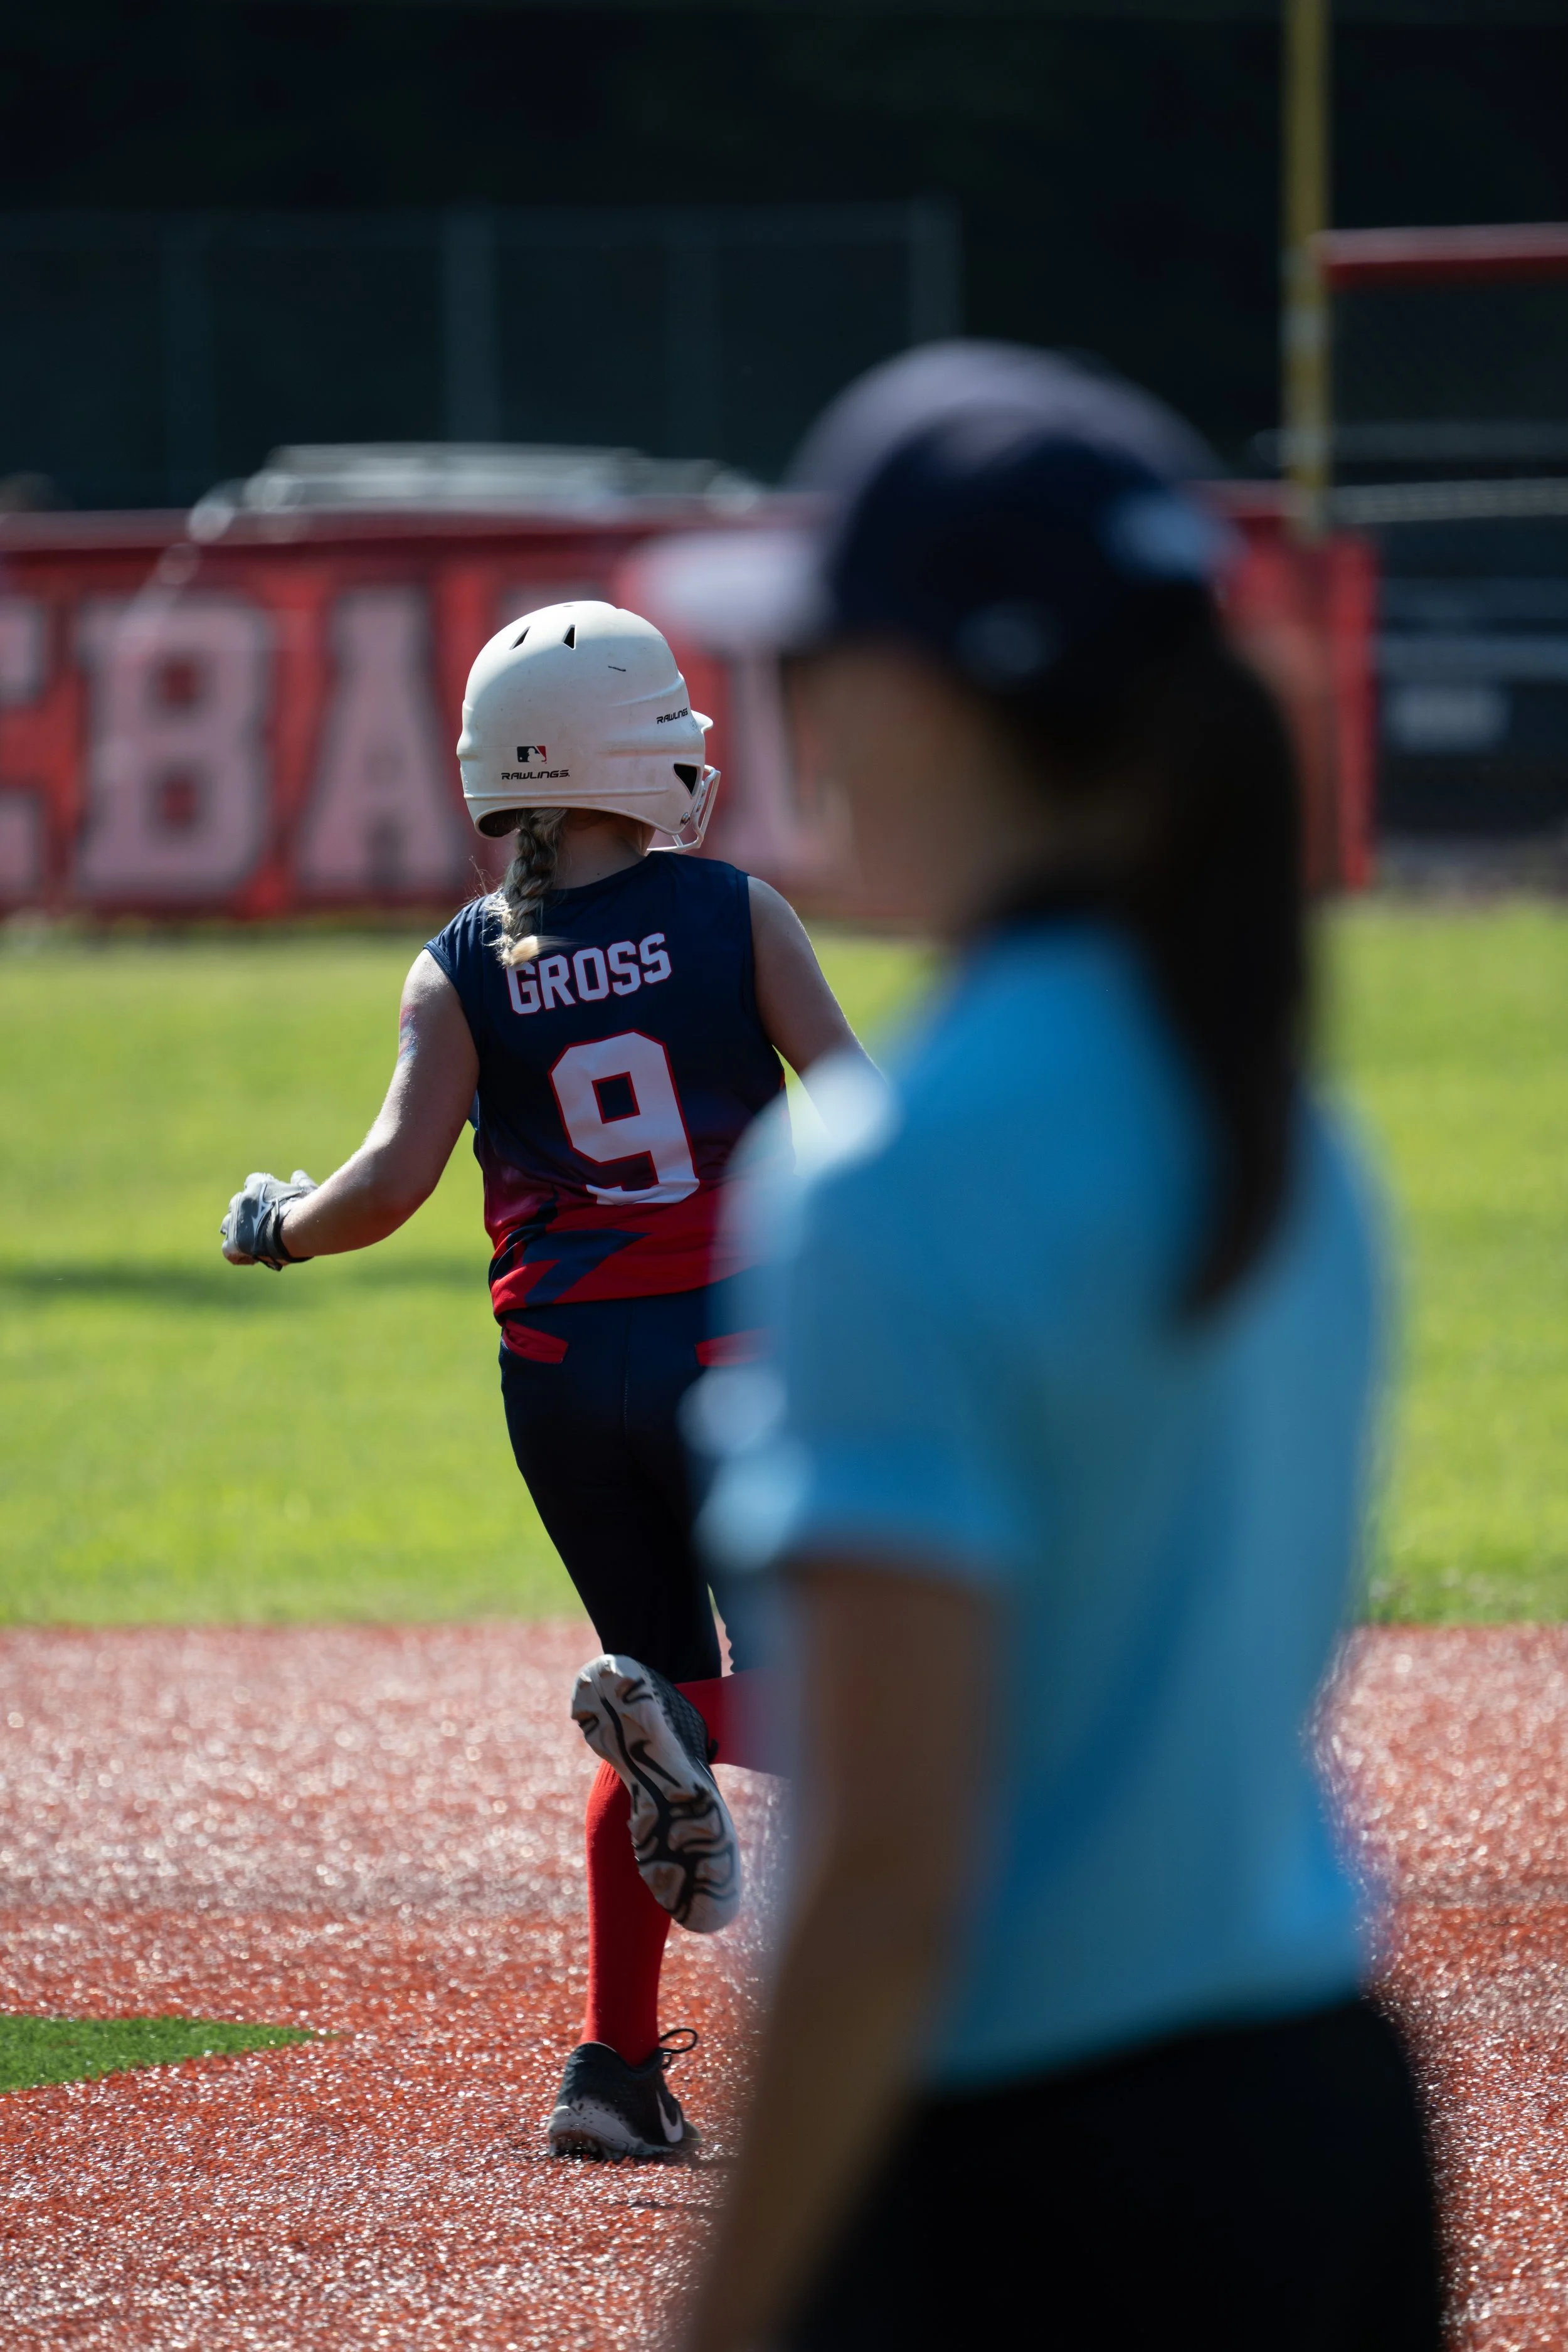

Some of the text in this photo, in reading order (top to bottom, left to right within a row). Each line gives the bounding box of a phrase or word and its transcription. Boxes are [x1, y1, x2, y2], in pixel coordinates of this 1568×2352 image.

[656, 707, 688, 724] RAWLINGS
[501, 770, 569, 780] RAWLINGS
[506, 933, 672, 1015] GROSS
[548, 1029, 700, 1205] 9
